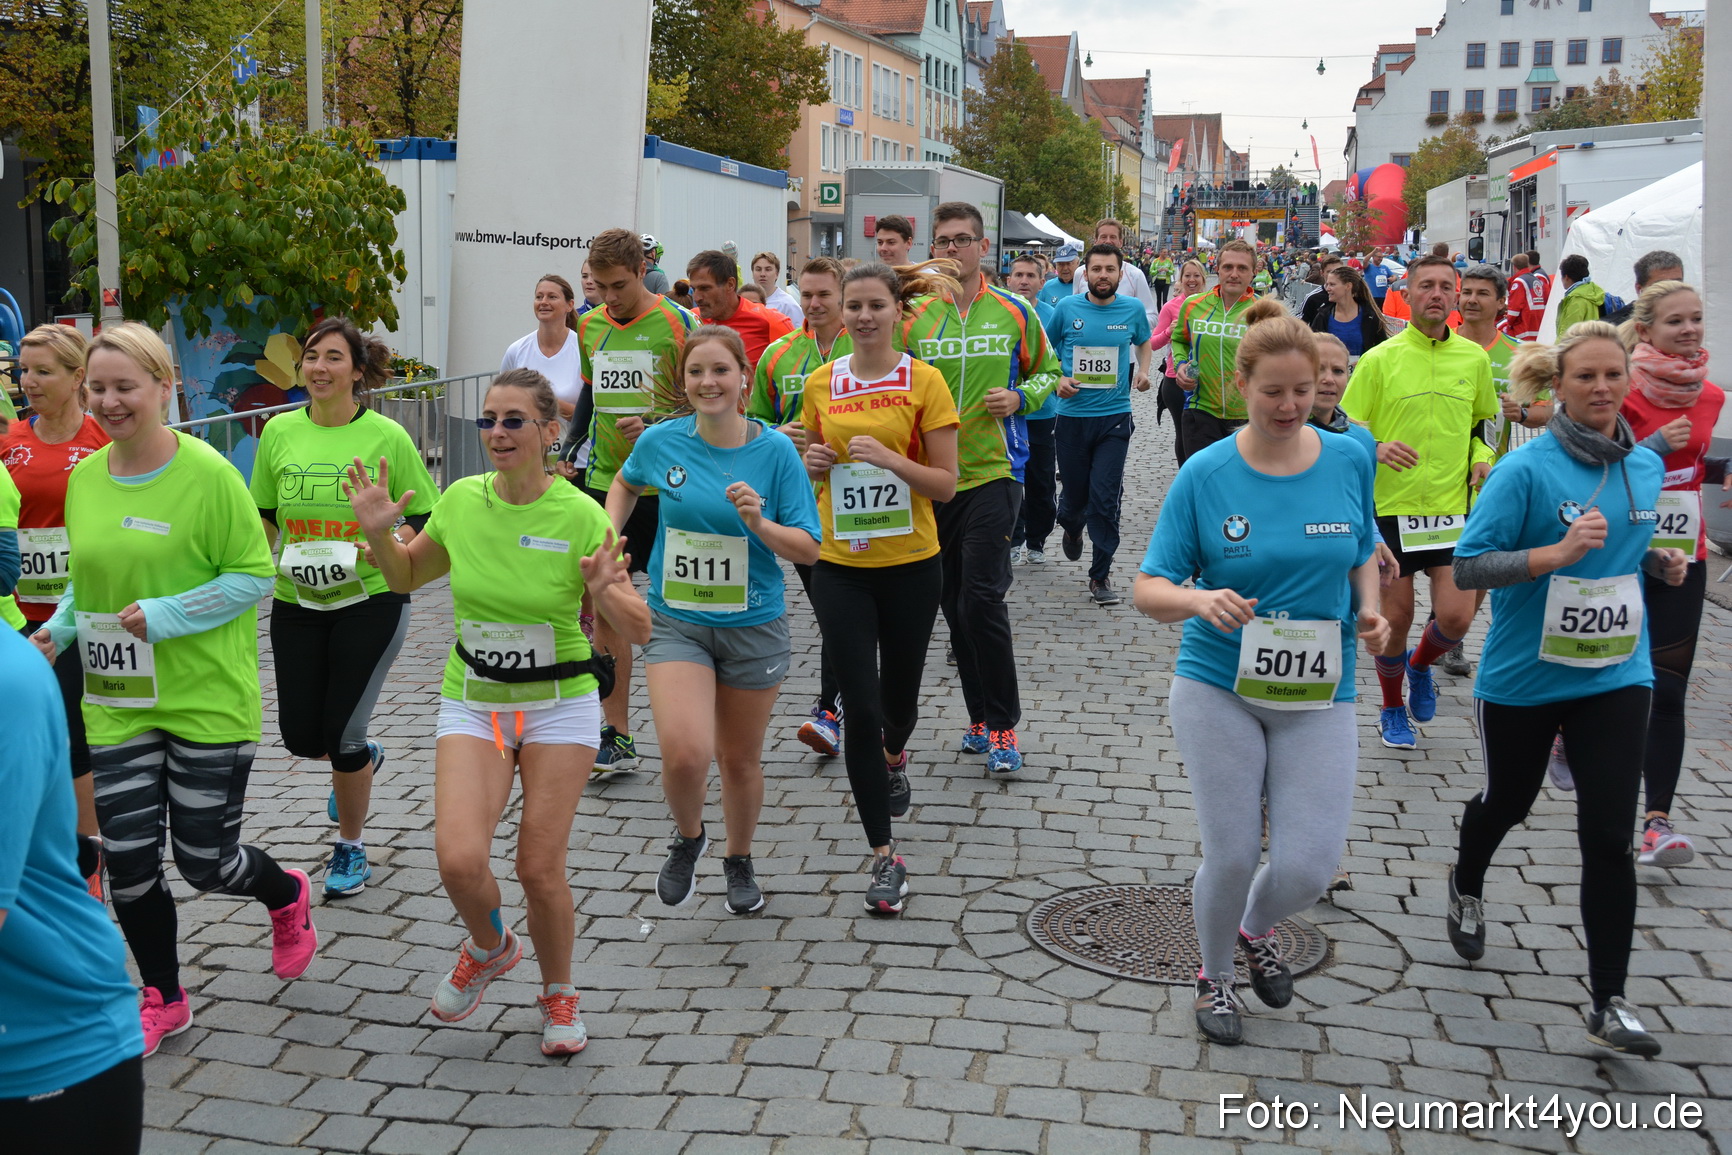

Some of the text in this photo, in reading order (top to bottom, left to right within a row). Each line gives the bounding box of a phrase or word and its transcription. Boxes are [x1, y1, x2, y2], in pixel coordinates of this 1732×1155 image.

[823, 186, 838, 201] D
[1232, 210, 1251, 218] ZIEL
[918, 335, 1012, 360] BOCK
[1079, 359, 1111, 372] 5183
[601, 370, 643, 389] 5230
[828, 394, 912, 415] MAX BÖGL
[844, 484, 898, 510] 5172
[286, 519, 361, 538] MERZ
[854, 515, 890, 525] Elisabeth
[1304, 523, 1352, 535] BOCK
[1223, 545, 1252, 554] PARTL
[21, 551, 70, 575] 5017
[675, 554, 731, 581] 5111
[291, 564, 347, 586] 5018
[37, 582, 64, 591] Andrea
[693, 588, 714, 598] Lena
[1560, 604, 1629, 633] 5204
[87, 641, 137, 671] 5041
[1576, 643, 1609, 654] Regine
[474, 649, 536, 669] 5221
[1255, 648, 1327, 678] 5014
[103, 680, 125, 691] Maria
[1266, 685, 1307, 696] Stefanie
